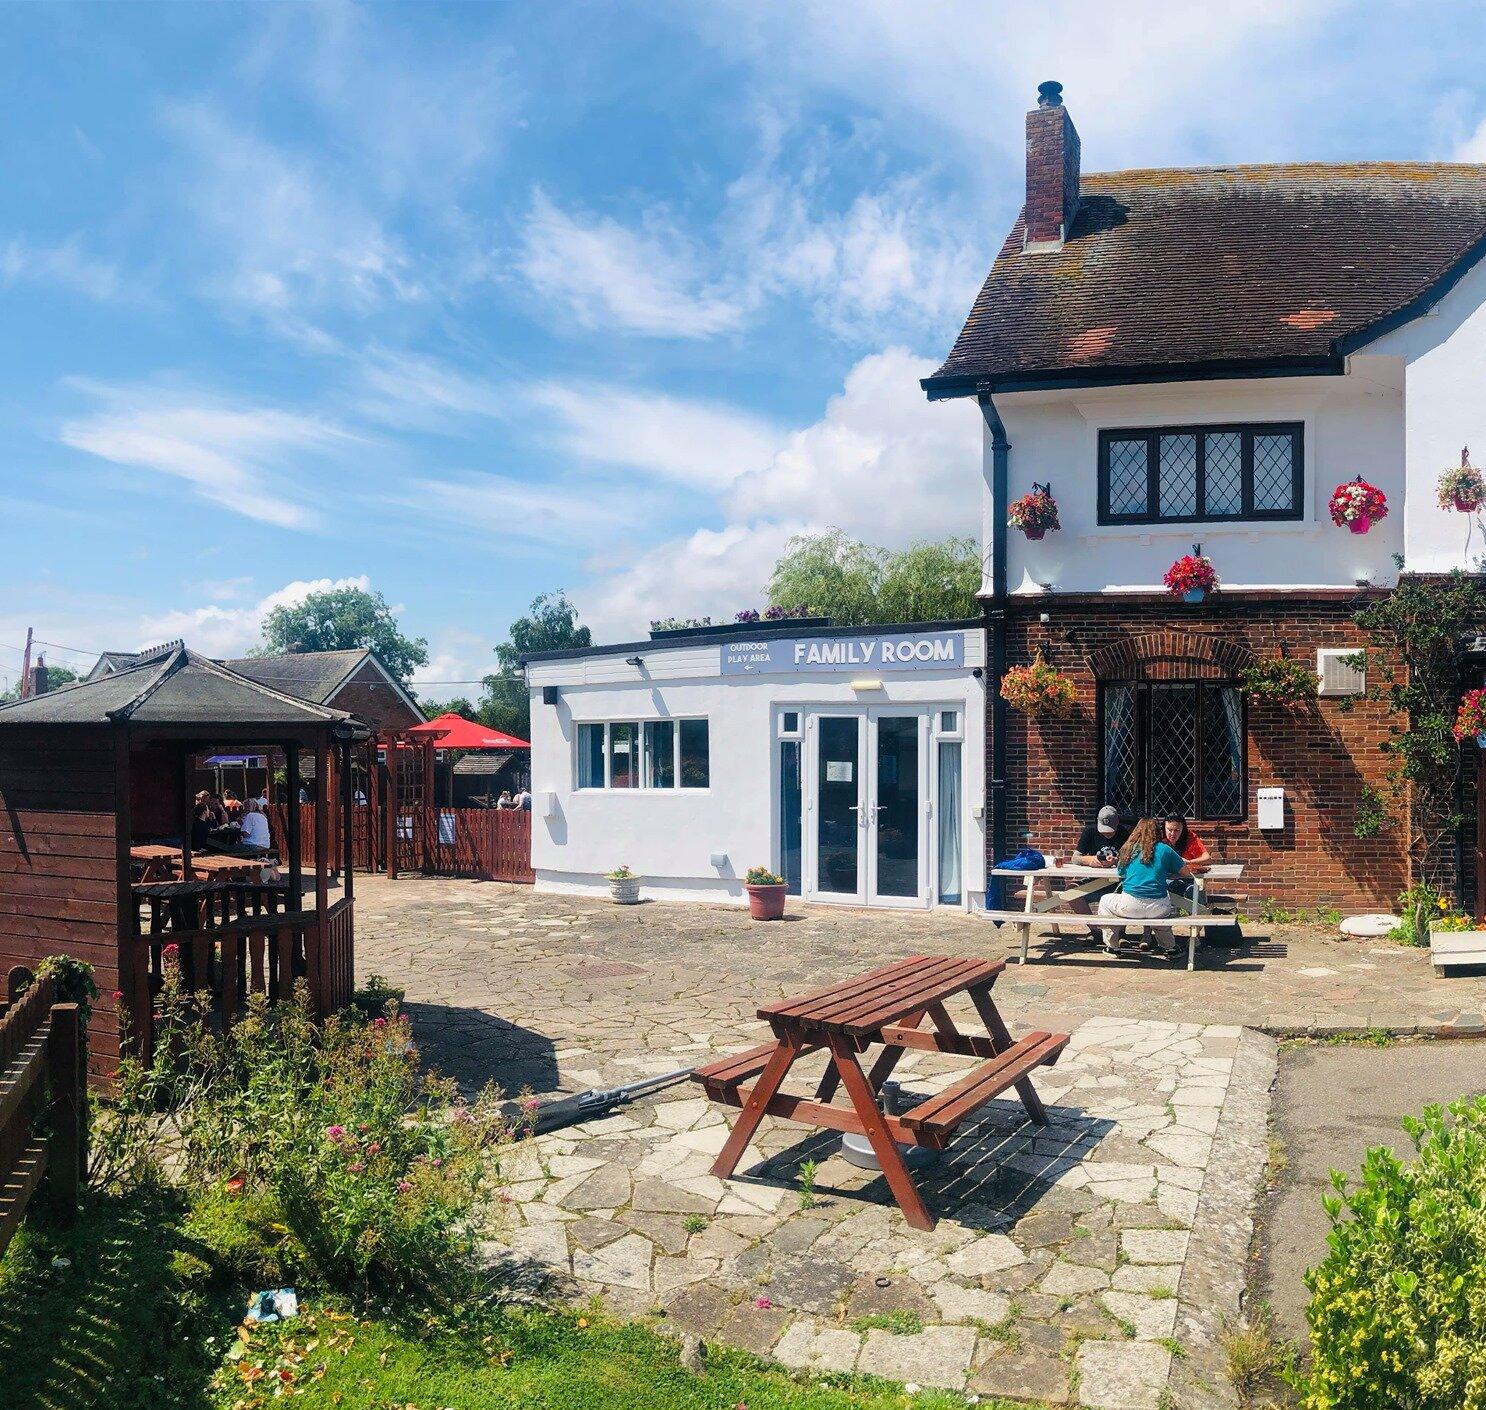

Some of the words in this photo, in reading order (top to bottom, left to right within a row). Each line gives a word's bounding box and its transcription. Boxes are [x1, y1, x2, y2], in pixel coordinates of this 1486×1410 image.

[730, 642, 768, 652] OUTDOOR
[794, 641, 877, 665] FAMILY
[881, 638, 955, 663] ROOM
[728, 654, 748, 664] PLAY
[750, 653, 771, 663] AREA
